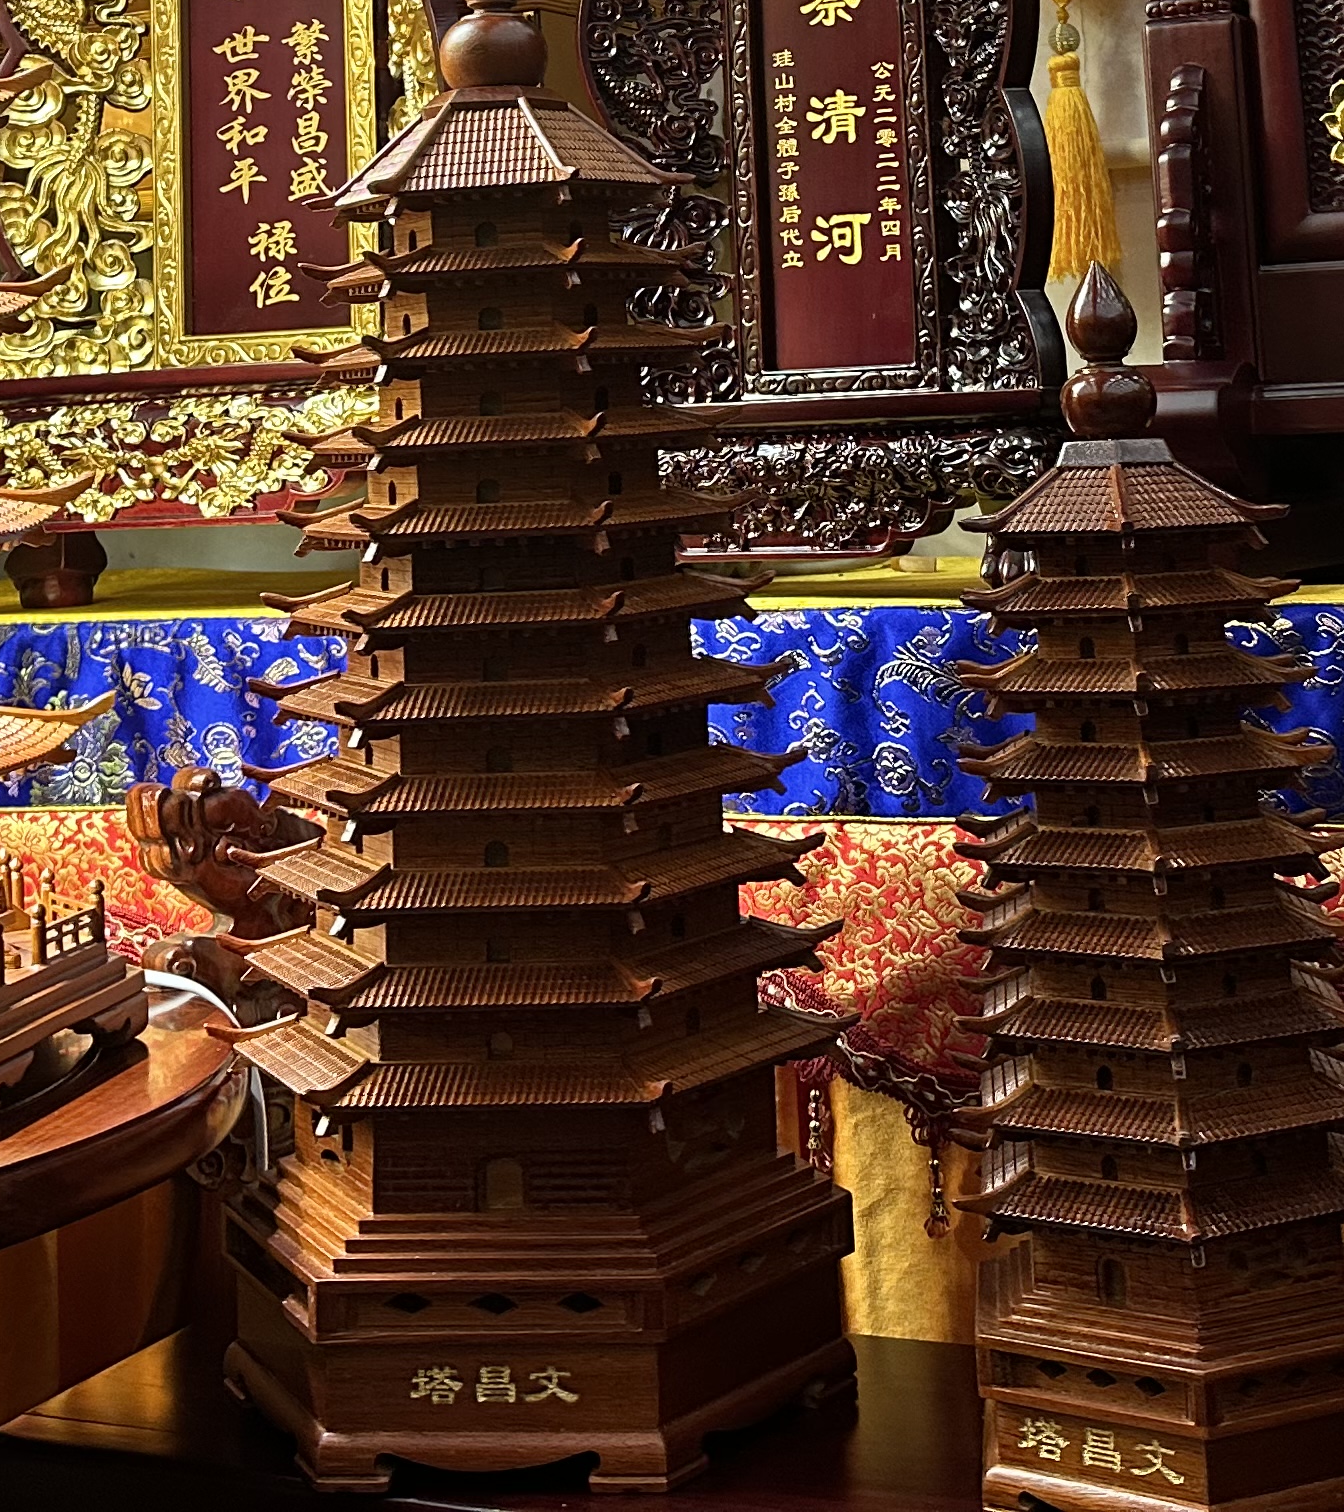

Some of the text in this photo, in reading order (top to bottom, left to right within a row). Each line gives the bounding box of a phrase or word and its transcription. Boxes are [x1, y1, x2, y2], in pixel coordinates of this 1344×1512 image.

[212, 25, 272, 205] 世界和平
[281, 18, 337, 202] 繁榮昌盛
[870, 61, 902, 262] 公元二零二二年四月
